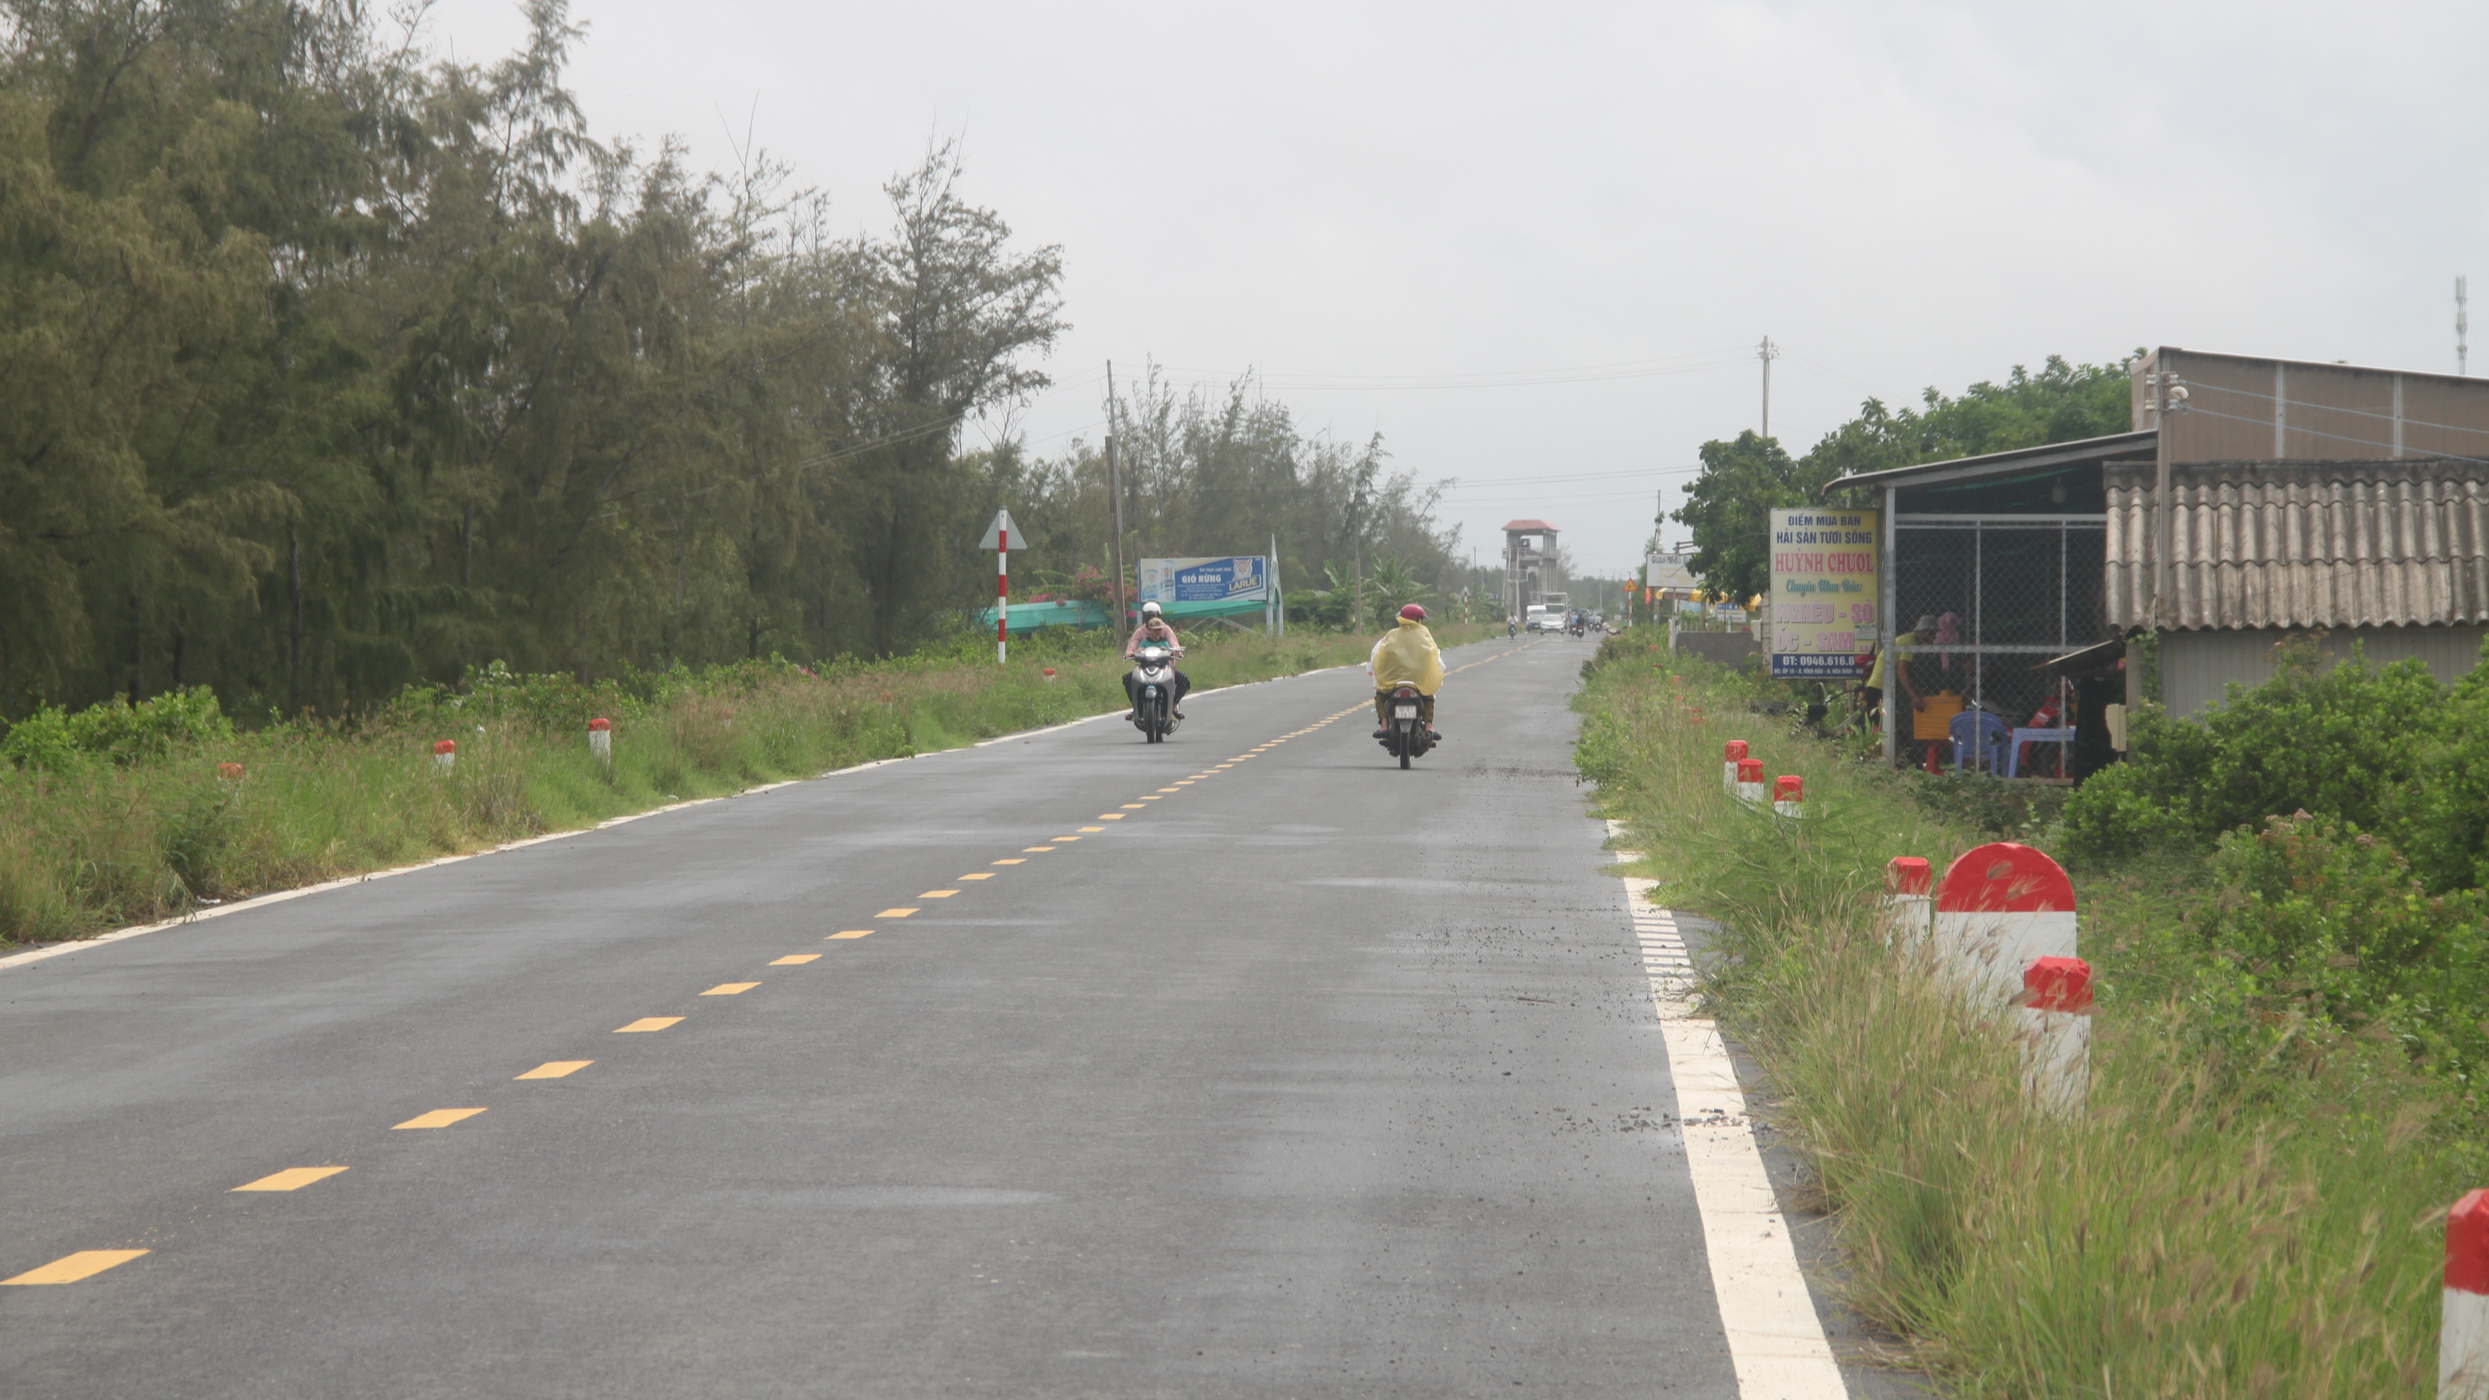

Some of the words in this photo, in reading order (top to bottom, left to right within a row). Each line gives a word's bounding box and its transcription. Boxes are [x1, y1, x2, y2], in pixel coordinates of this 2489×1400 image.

[1788, 512, 1813, 526] ĐIỂM
[1816, 516, 1838, 526] MUA
[1840, 513, 1861, 526] BÁN
[1776, 527, 1793, 544] HẢI
[1796, 527, 1817, 544] SẢN
[1820, 531, 1842, 544] TƯƠI
[1845, 527, 1872, 544] SỐNG
[1775, 547, 1824, 573] HUỲNH
[1827, 553, 1874, 573] CHUOL
[1181, 573, 1197, 584] GIÓ
[1229, 577, 1258, 591] LARUE
[1818, 579, 1840, 593] Mua
[1776, 599, 1834, 624] NGHÊU
[1816, 631, 1855, 652] SAM
[1783, 656, 1798, 666] ĐT:
[1800, 655, 1855, 666] 0946.616.6
